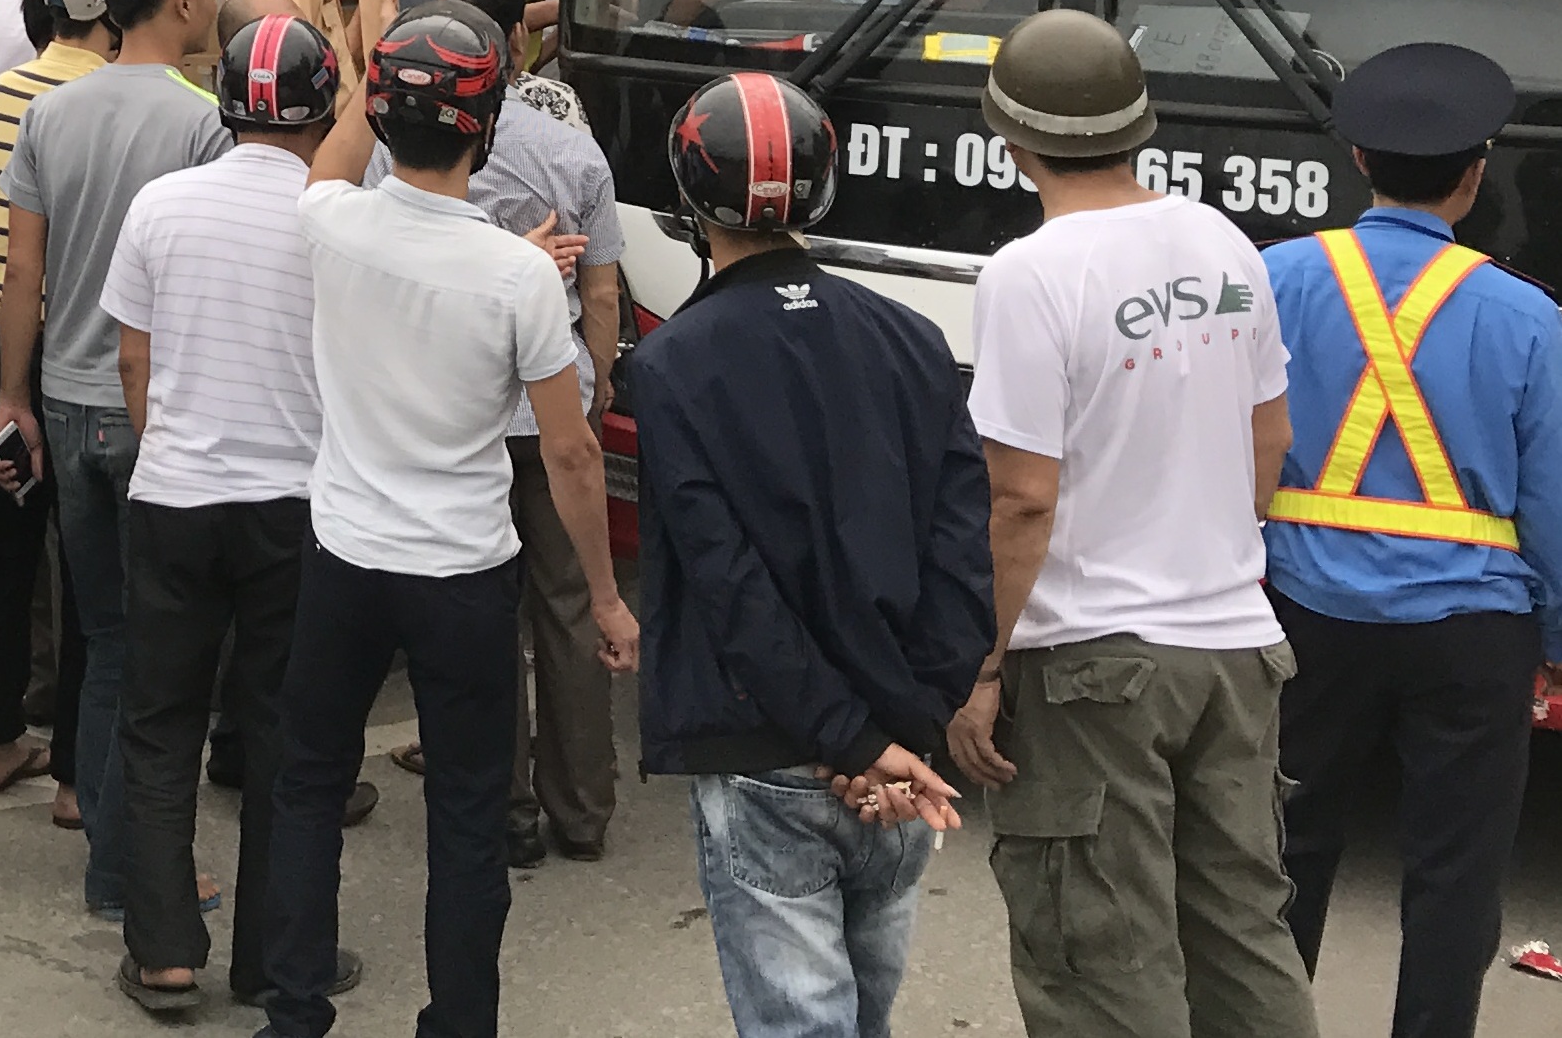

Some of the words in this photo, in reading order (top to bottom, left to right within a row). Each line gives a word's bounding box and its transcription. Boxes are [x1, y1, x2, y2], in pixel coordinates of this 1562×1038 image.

[847, 123, 910, 179] ĐT
[1222, 155, 1329, 218] 358
[783, 299, 818, 311] adidas
